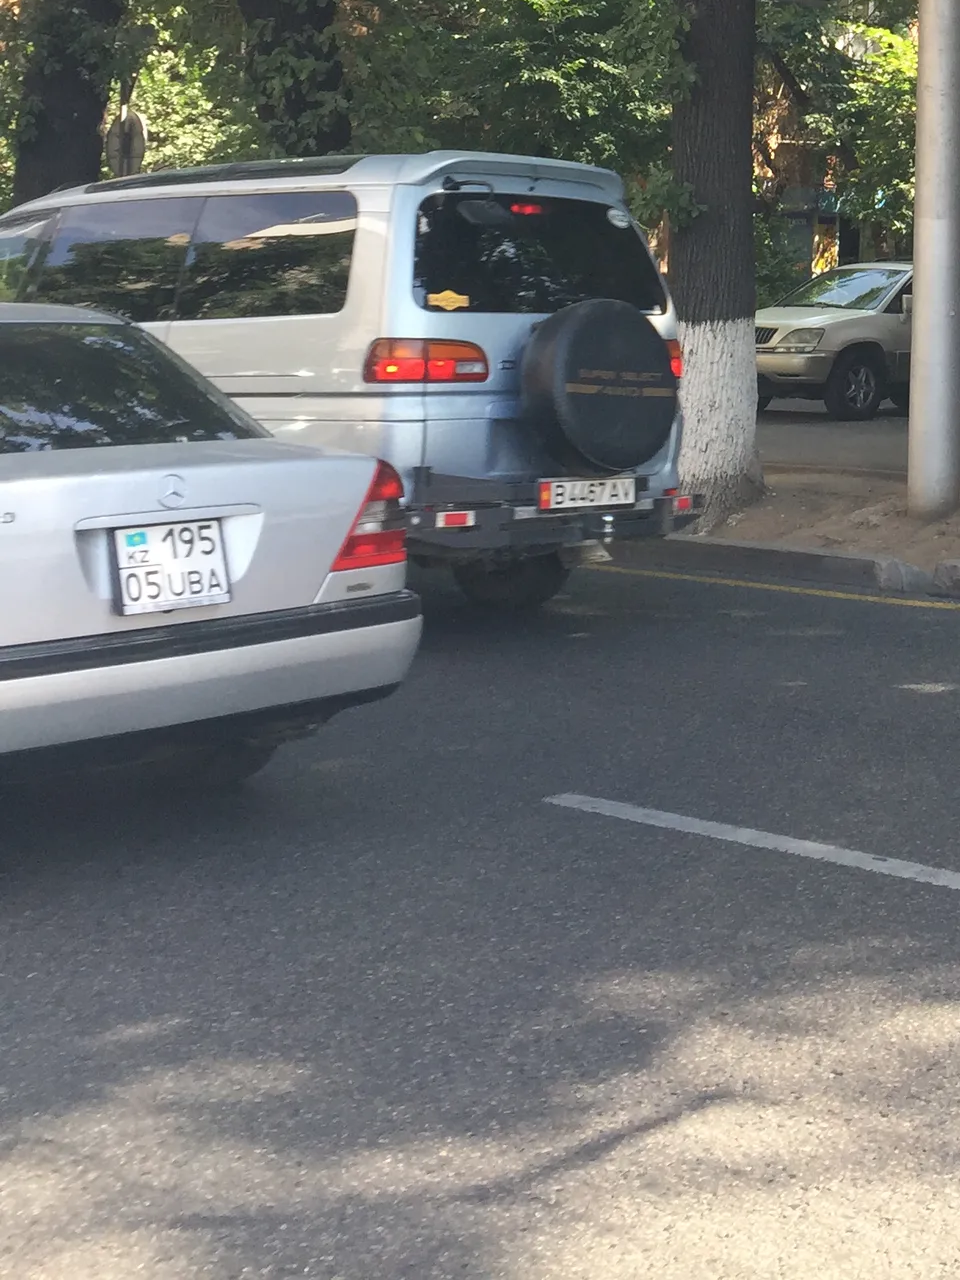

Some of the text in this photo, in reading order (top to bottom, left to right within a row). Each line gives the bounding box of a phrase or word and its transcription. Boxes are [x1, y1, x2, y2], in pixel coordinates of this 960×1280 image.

[127, 524, 216, 564] KZ 195
[125, 568, 223, 602] 05 UBA
